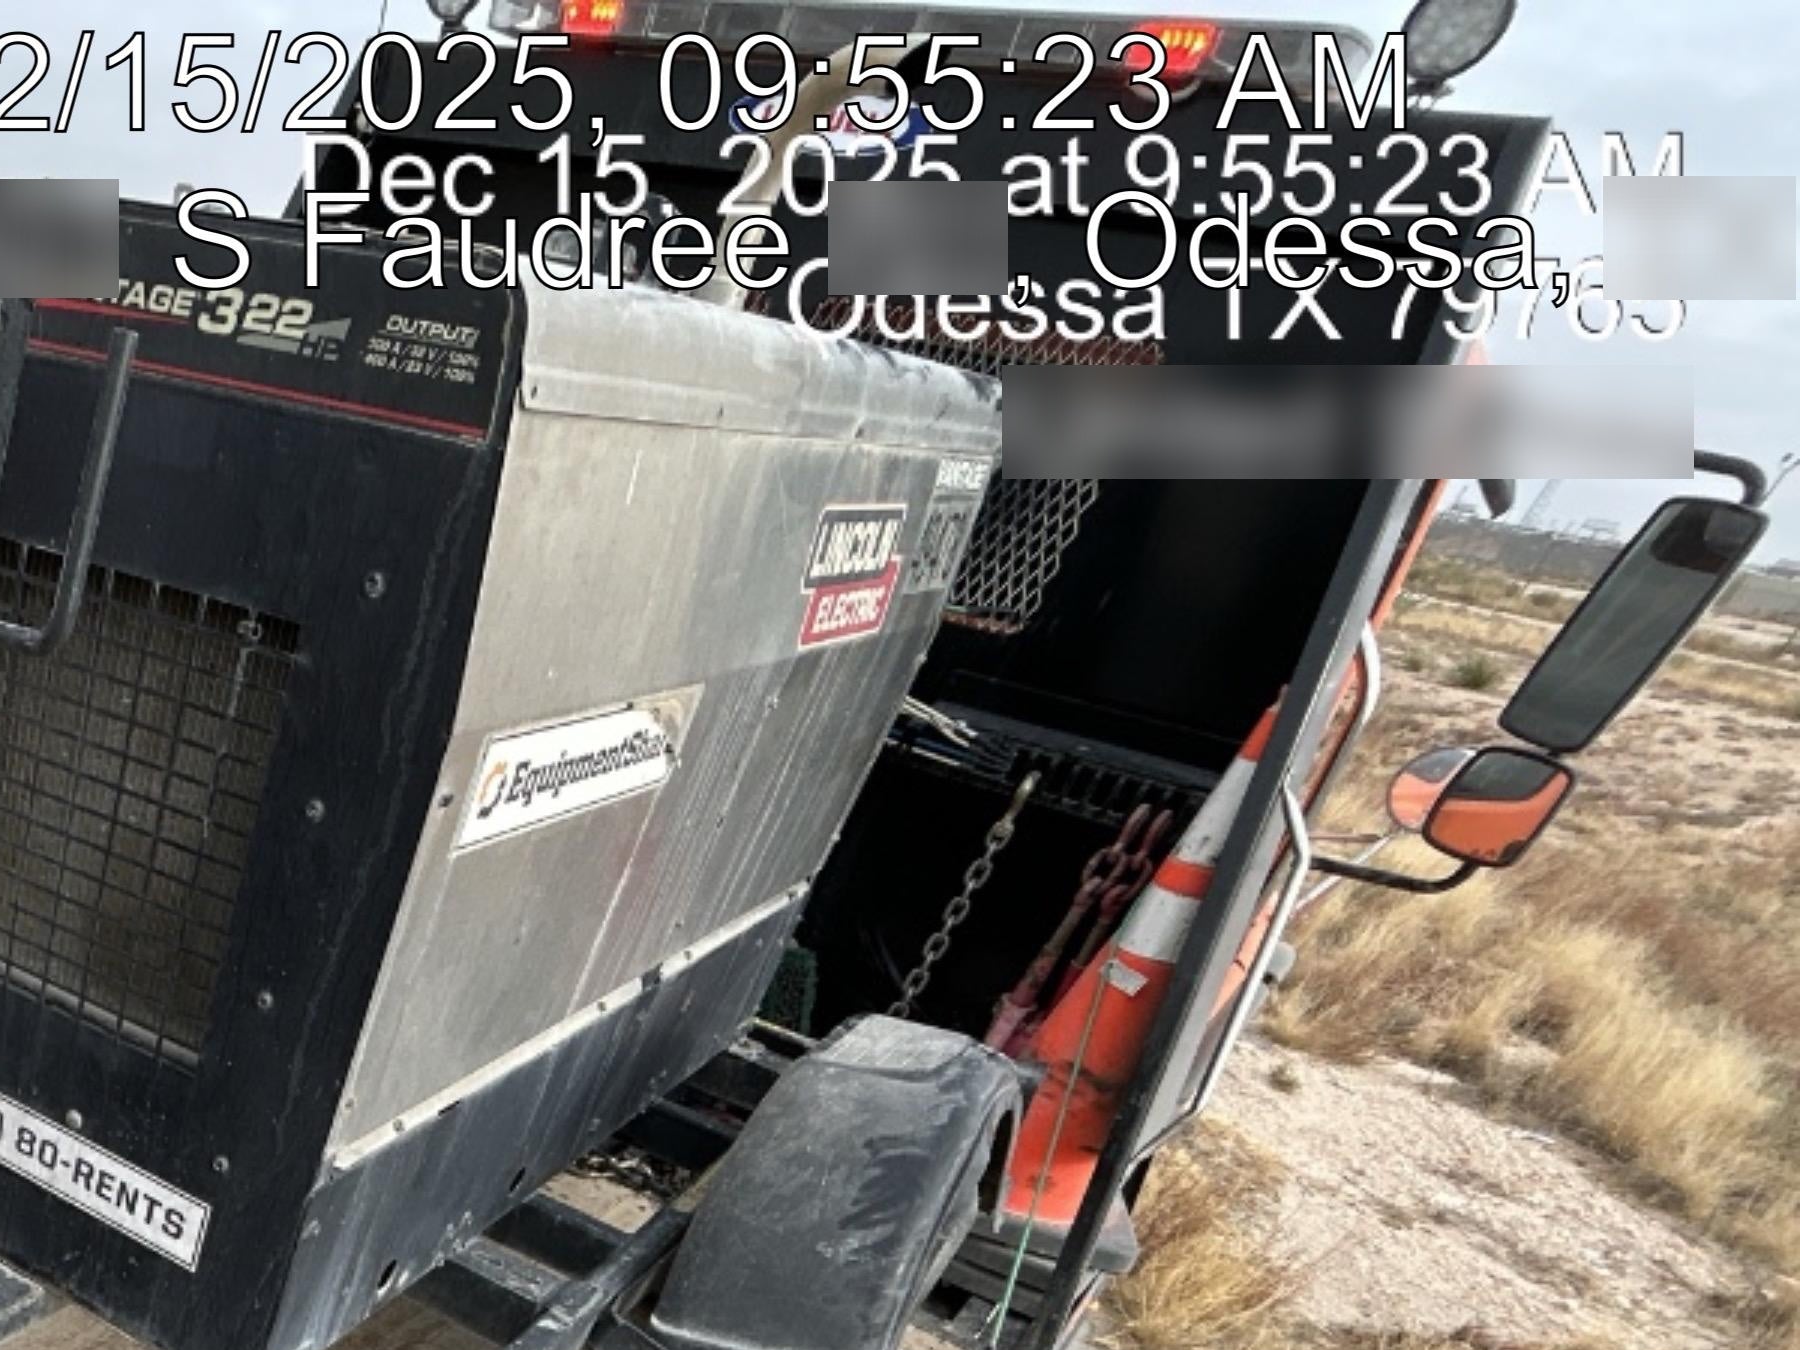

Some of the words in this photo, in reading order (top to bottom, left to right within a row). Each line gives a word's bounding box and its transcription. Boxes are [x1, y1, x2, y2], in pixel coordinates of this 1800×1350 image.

[197, 286, 314, 340] 322
[808, 518, 902, 580] LINCOLN
[811, 585, 887, 634] ELECTRIC
[14, 1125, 187, 1241] 80-RENTS
